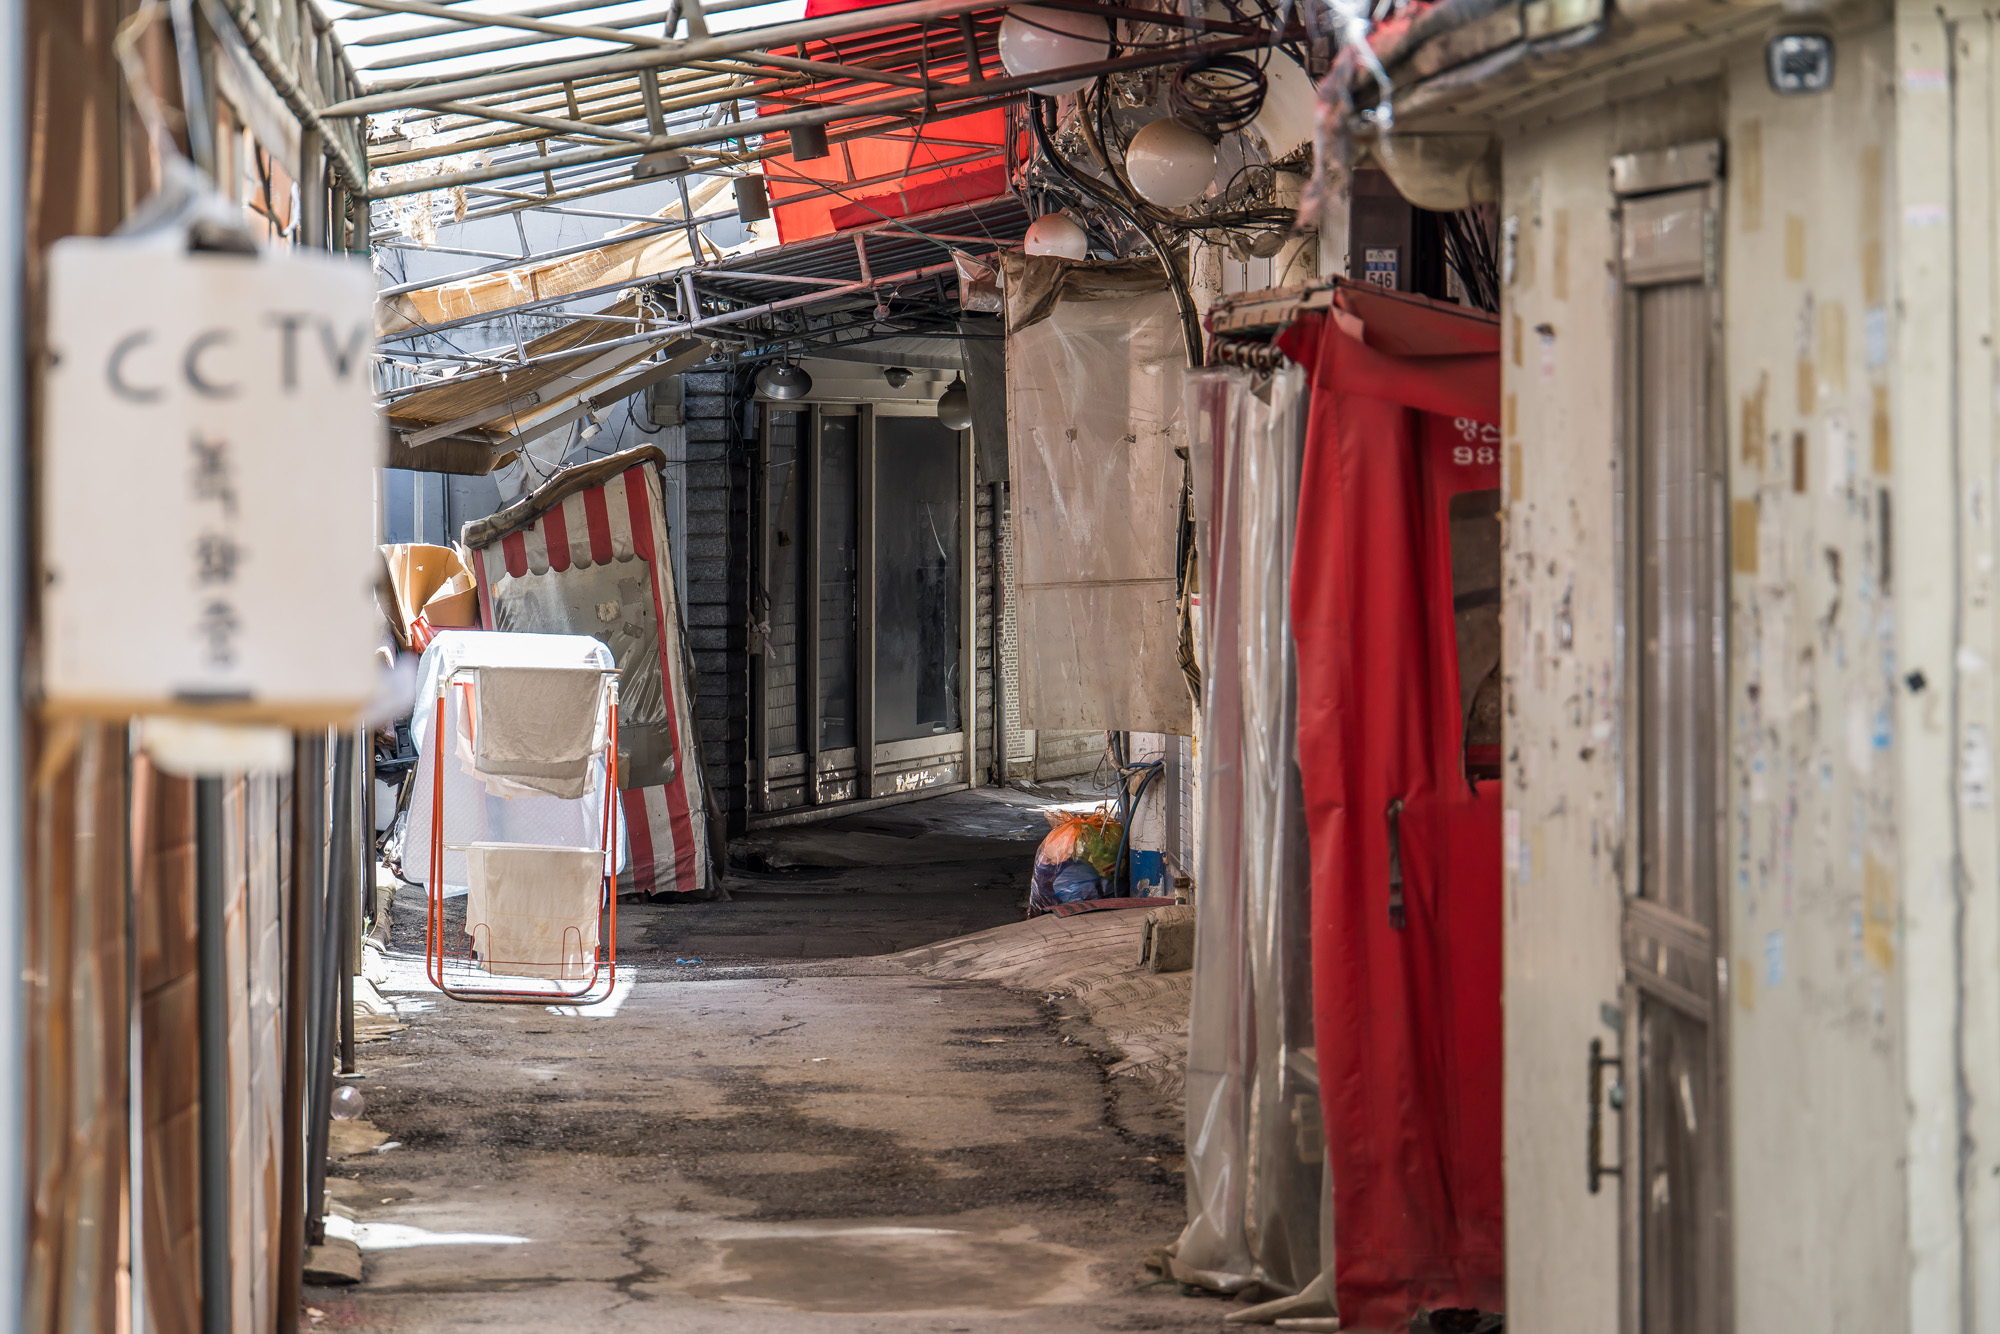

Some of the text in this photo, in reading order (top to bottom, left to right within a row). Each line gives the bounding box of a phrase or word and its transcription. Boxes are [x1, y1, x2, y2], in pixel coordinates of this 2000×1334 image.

[1368, 272, 1393, 289] 546
[104, 309, 371, 405] CCTV
[1453, 446, 1502, 465] 98
